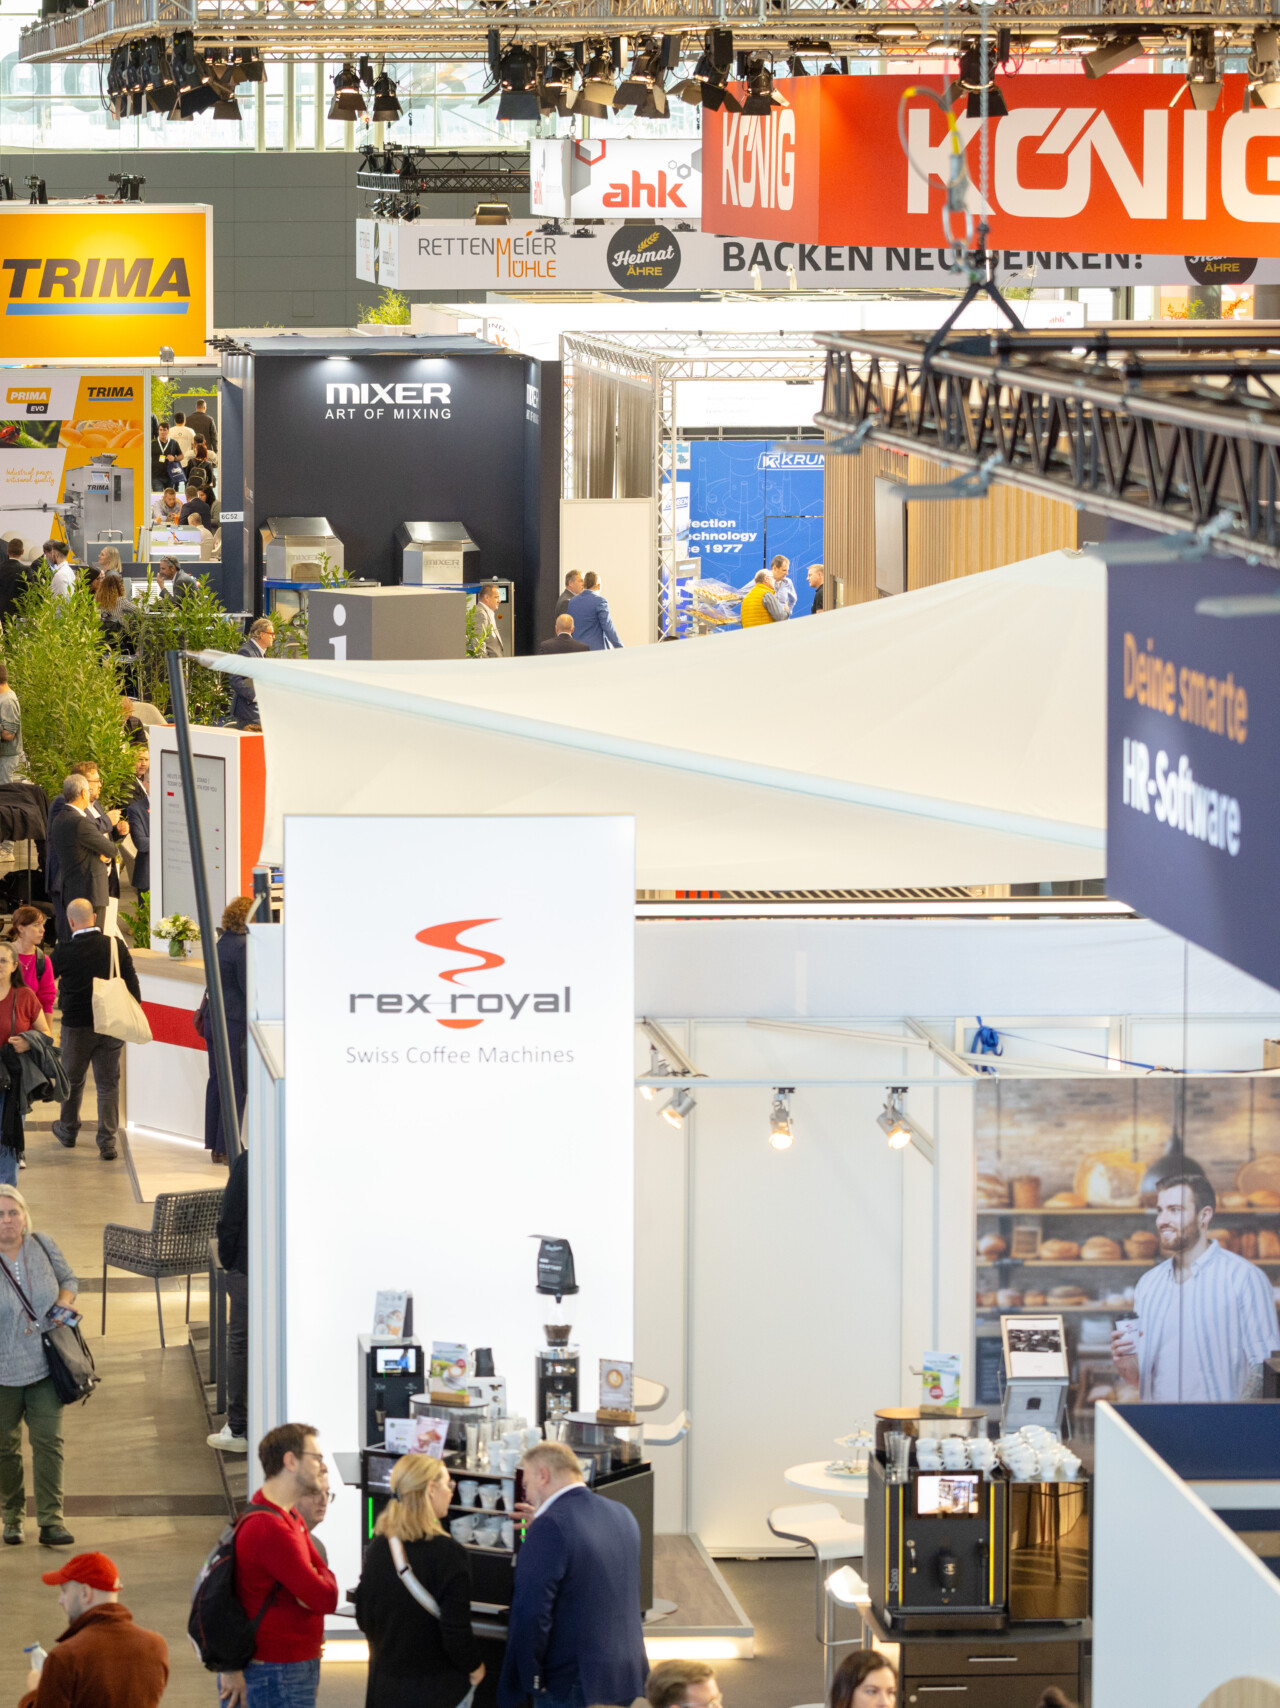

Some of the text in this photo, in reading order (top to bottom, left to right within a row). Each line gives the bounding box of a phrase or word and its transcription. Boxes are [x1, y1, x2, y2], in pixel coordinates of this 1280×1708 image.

[602, 170, 687, 208] ahk
[612, 245, 675, 267] Heimat
[723, 242, 872, 271] BACKEN
[2, 258, 191, 298] TRIMA
[626, 265, 663, 276] ÄHRE
[1204, 262, 1240, 273] ÄHRE
[10, 391, 46, 400] PRIMA
[87, 387, 134, 397] TRIMA
[326, 383, 450, 404] MIXER
[325, 409, 451, 419] ART OF MIXING
[705, 544, 743, 553] 1977
[1123, 631, 1249, 745] Deine smarte
[1122, 737, 1241, 857] HR-Software
[349, 986, 571, 1019] rex royal
[346, 1046, 574, 1063] Swiss Coffee Machines
